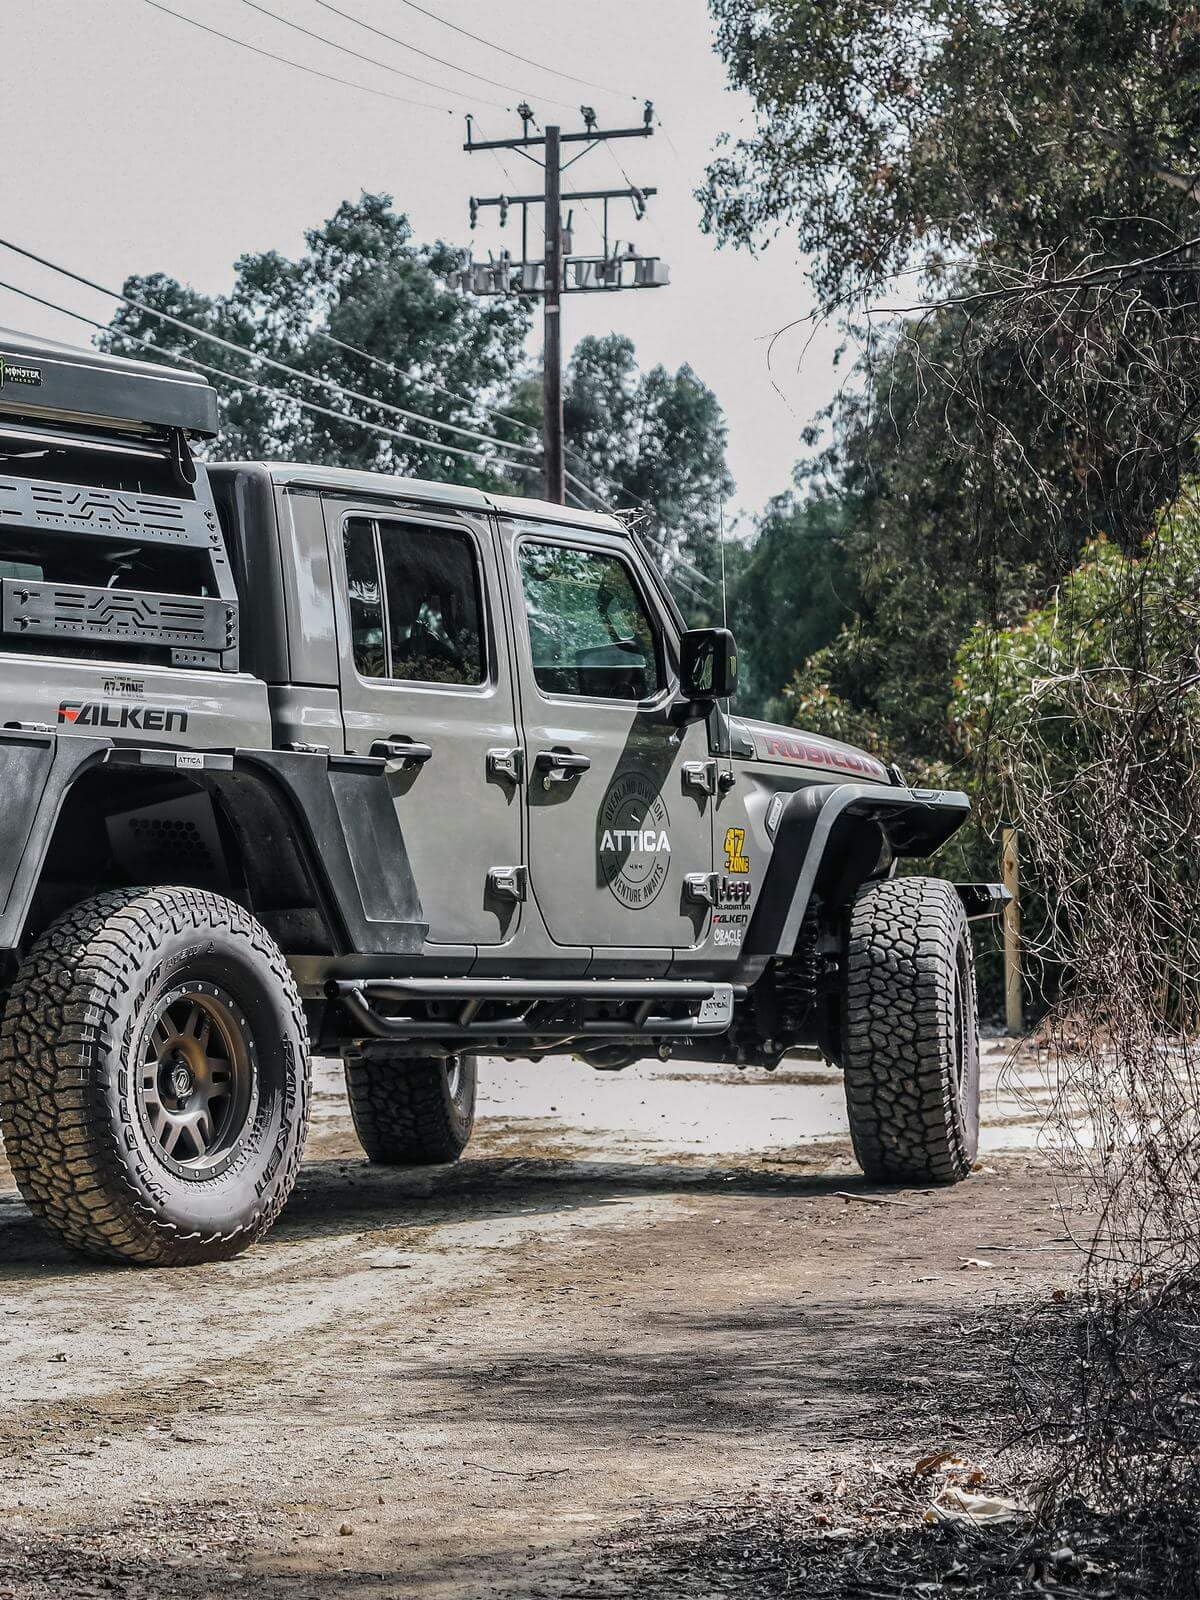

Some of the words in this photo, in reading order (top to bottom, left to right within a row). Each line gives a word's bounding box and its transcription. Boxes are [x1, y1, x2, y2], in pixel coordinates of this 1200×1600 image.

[4, 366, 40, 380] MONSTER
[57, 700, 188, 732] FALKEN
[763, 736, 881, 776] RUBICON
[605, 780, 636, 821] OVERLAND
[638, 782, 664, 821] DIVISION
[600, 829, 671, 852] ATTICA
[724, 828, 745, 857] 47
[607, 863, 642, 903] ADVENTURE
[643, 863, 664, 898] AWAITS
[712, 914, 748, 924] FALKEN
[716, 903, 751, 911] GLADIATOR
[714, 928, 742, 941] ORACLE
